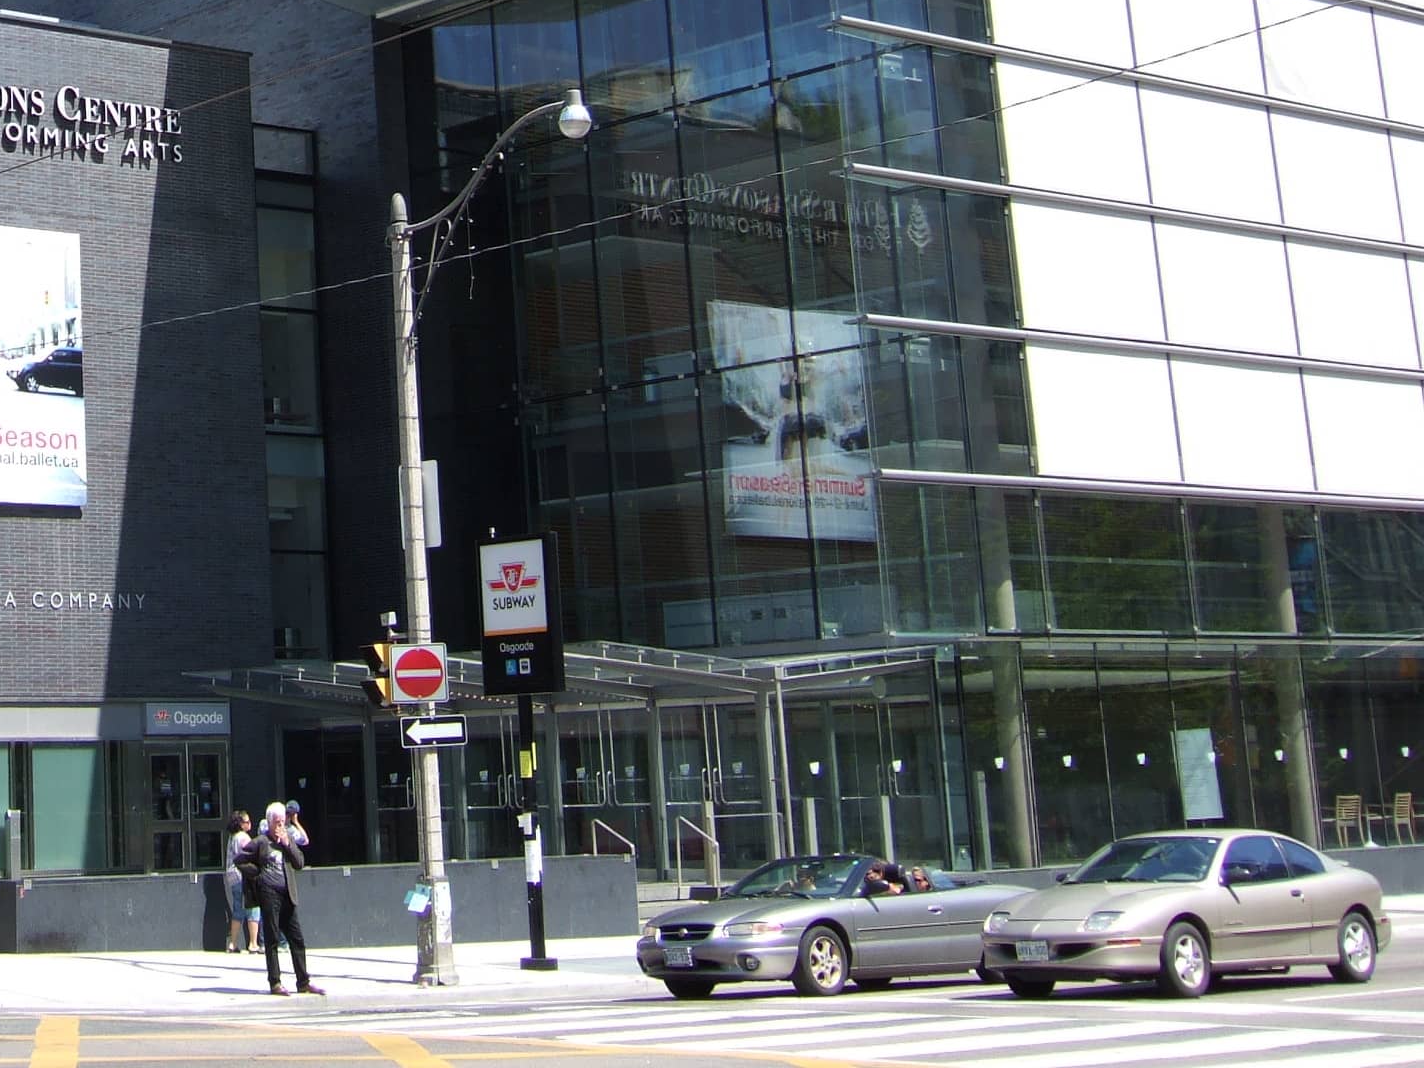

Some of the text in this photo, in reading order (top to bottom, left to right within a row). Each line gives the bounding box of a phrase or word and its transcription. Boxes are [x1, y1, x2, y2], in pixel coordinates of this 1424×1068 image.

[57, 85, 182, 135] CENTRE
[124, 140, 183, 163] ARTS
[32, 591, 147, 610] COMPANY
[493, 595, 536, 610] SUBWAY
[499, 642, 534, 653] Osgoode
[174, 711, 224, 726] Osgoode
